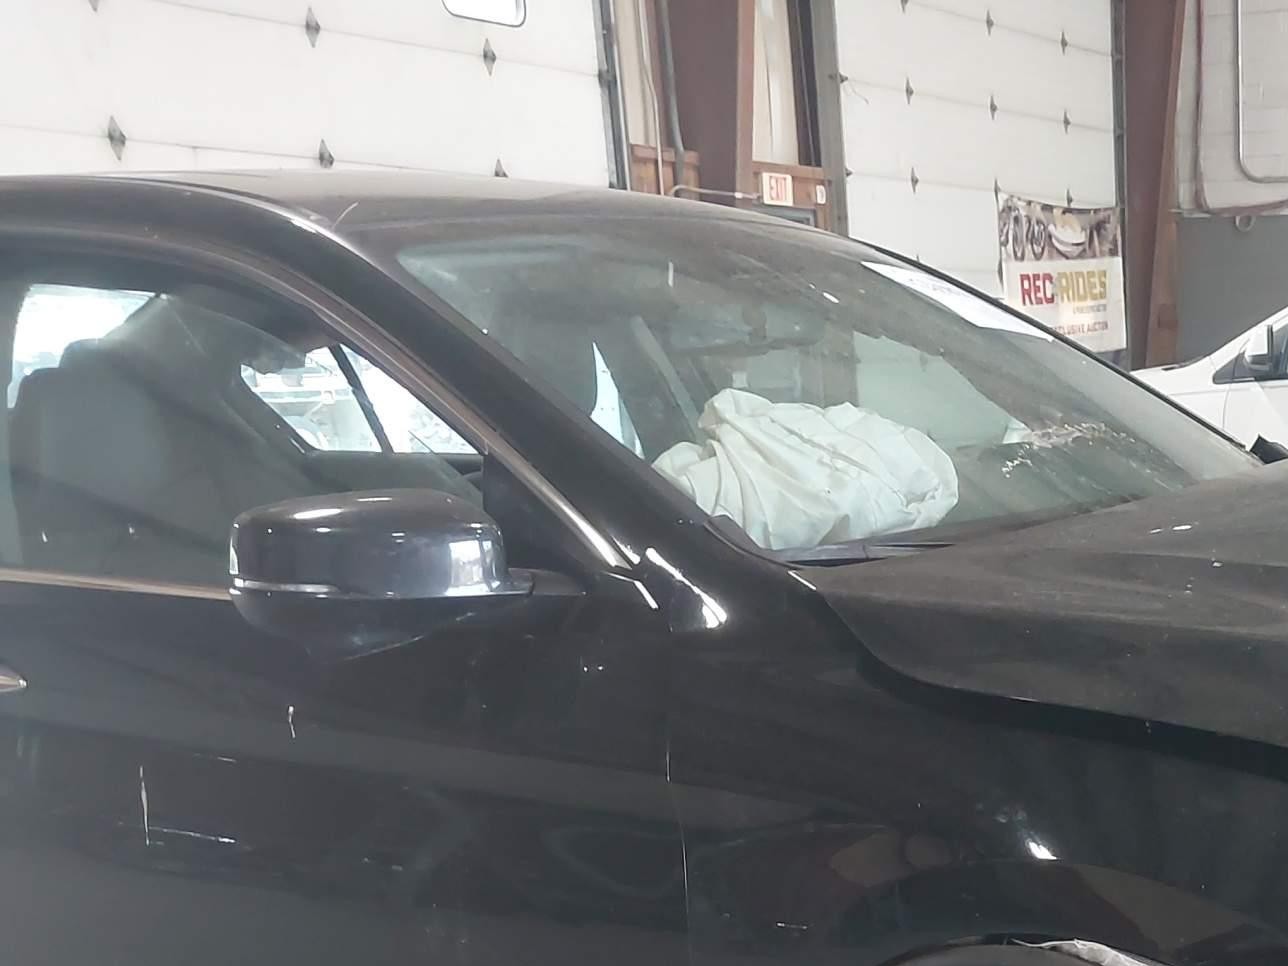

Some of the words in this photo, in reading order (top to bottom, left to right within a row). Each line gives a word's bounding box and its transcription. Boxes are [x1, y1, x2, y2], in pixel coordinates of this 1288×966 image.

[768, 175, 787, 201] EXIT
[1020, 273, 1055, 306] REC
[1058, 270, 1107, 302] RIDES
